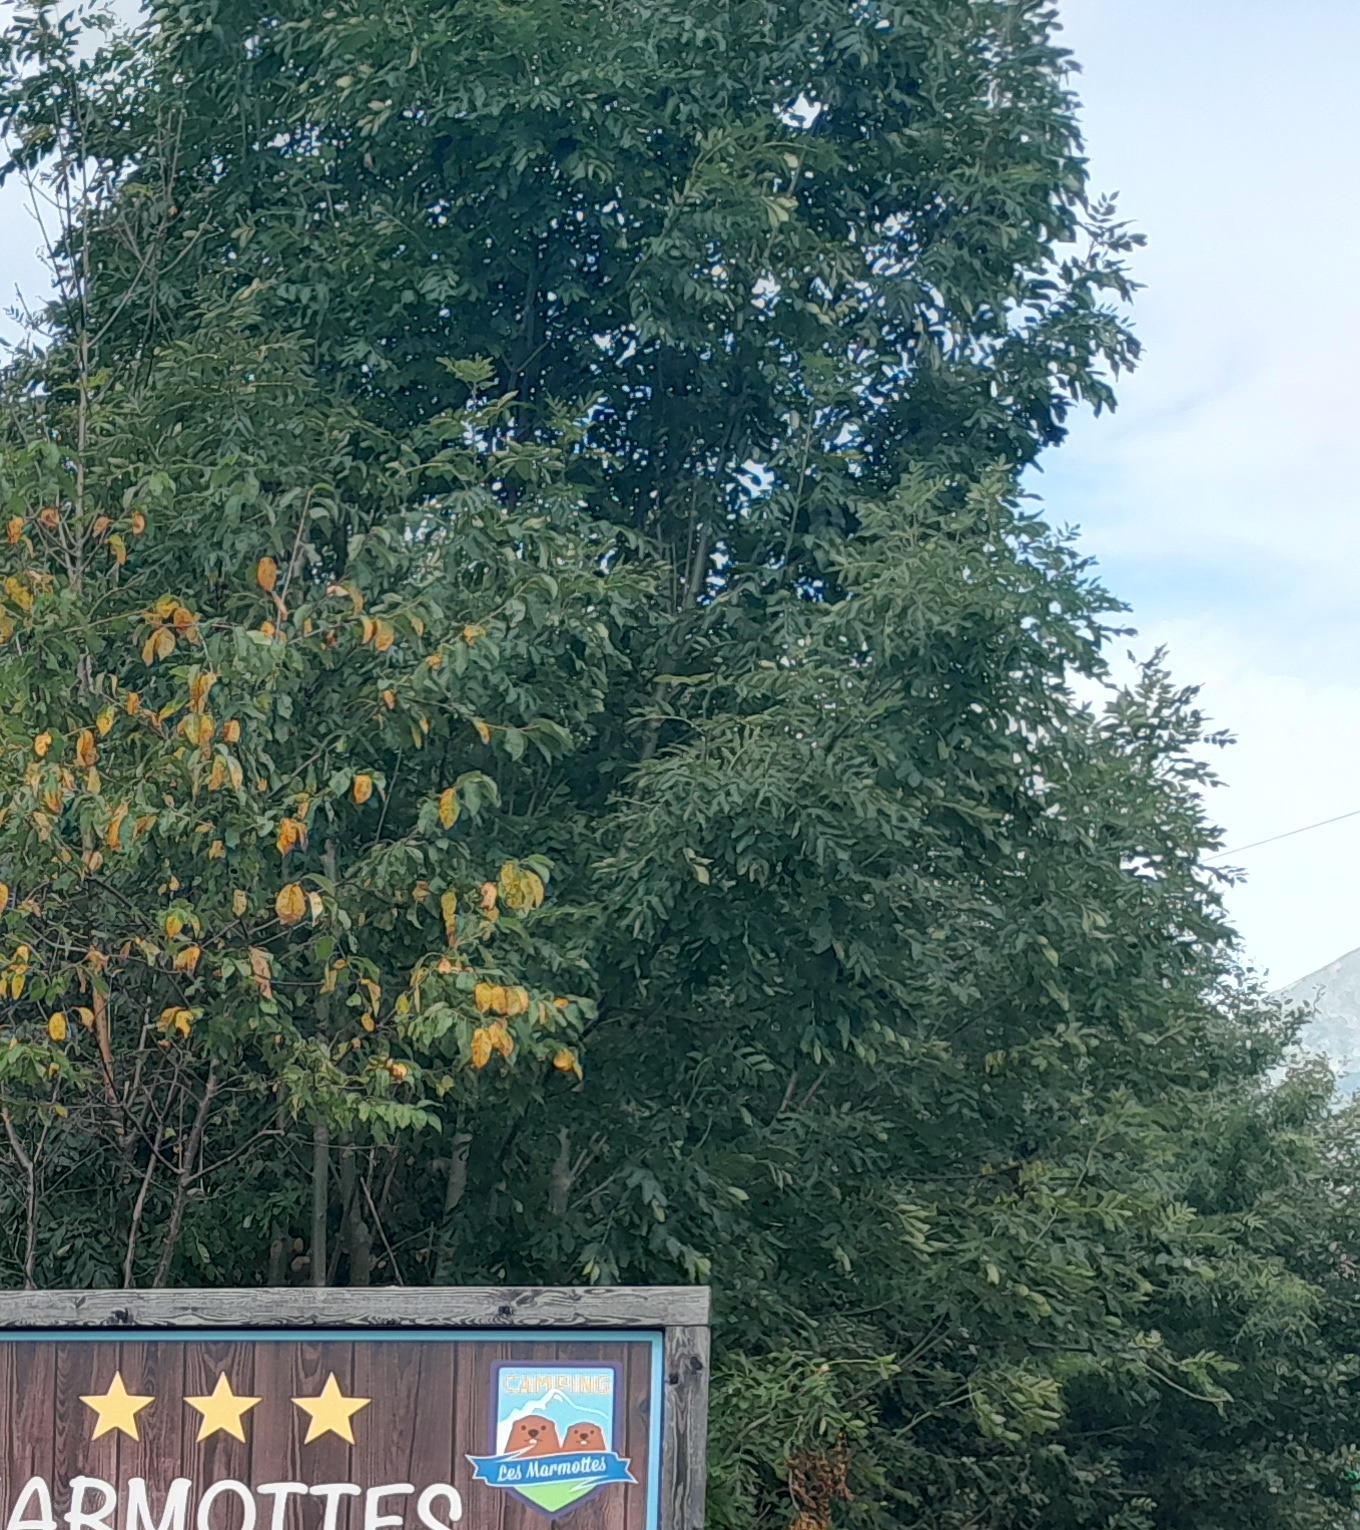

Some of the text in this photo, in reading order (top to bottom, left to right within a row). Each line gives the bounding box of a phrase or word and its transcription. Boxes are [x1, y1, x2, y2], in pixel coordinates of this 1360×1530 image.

[503, 1373, 611, 1395] CAMPING
[497, 1455, 607, 1482] Les Marmottes
